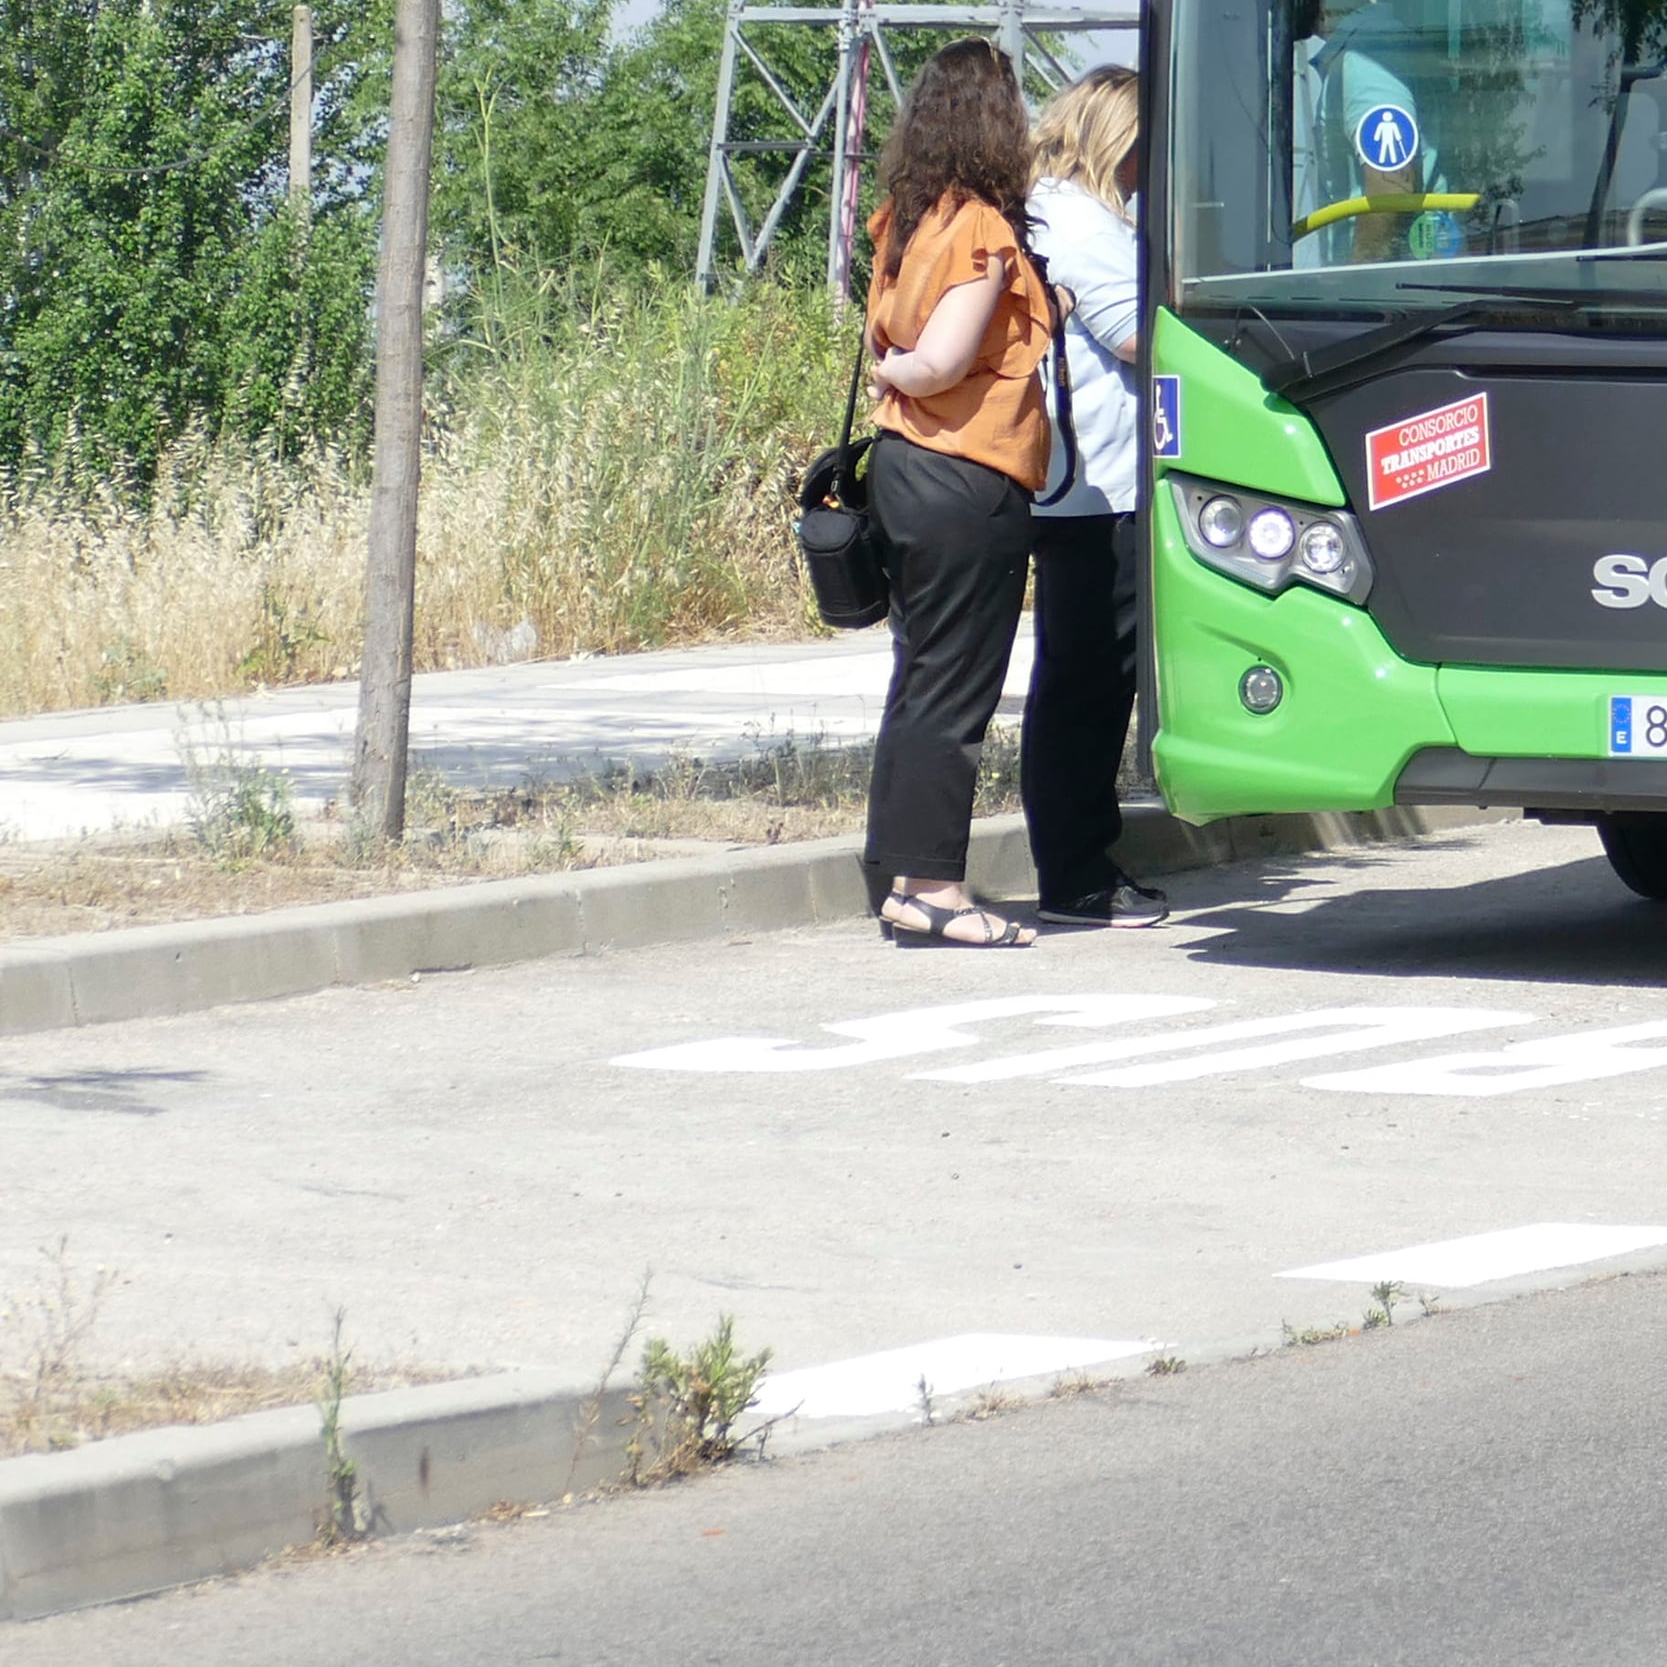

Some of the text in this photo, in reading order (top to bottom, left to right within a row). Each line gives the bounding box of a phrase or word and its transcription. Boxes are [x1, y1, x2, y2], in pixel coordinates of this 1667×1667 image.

[1398, 403, 1479, 447] CONSORCIO
[1380, 425, 1481, 475] TRANSPORTES
[1426, 447, 1481, 482] MADRID
